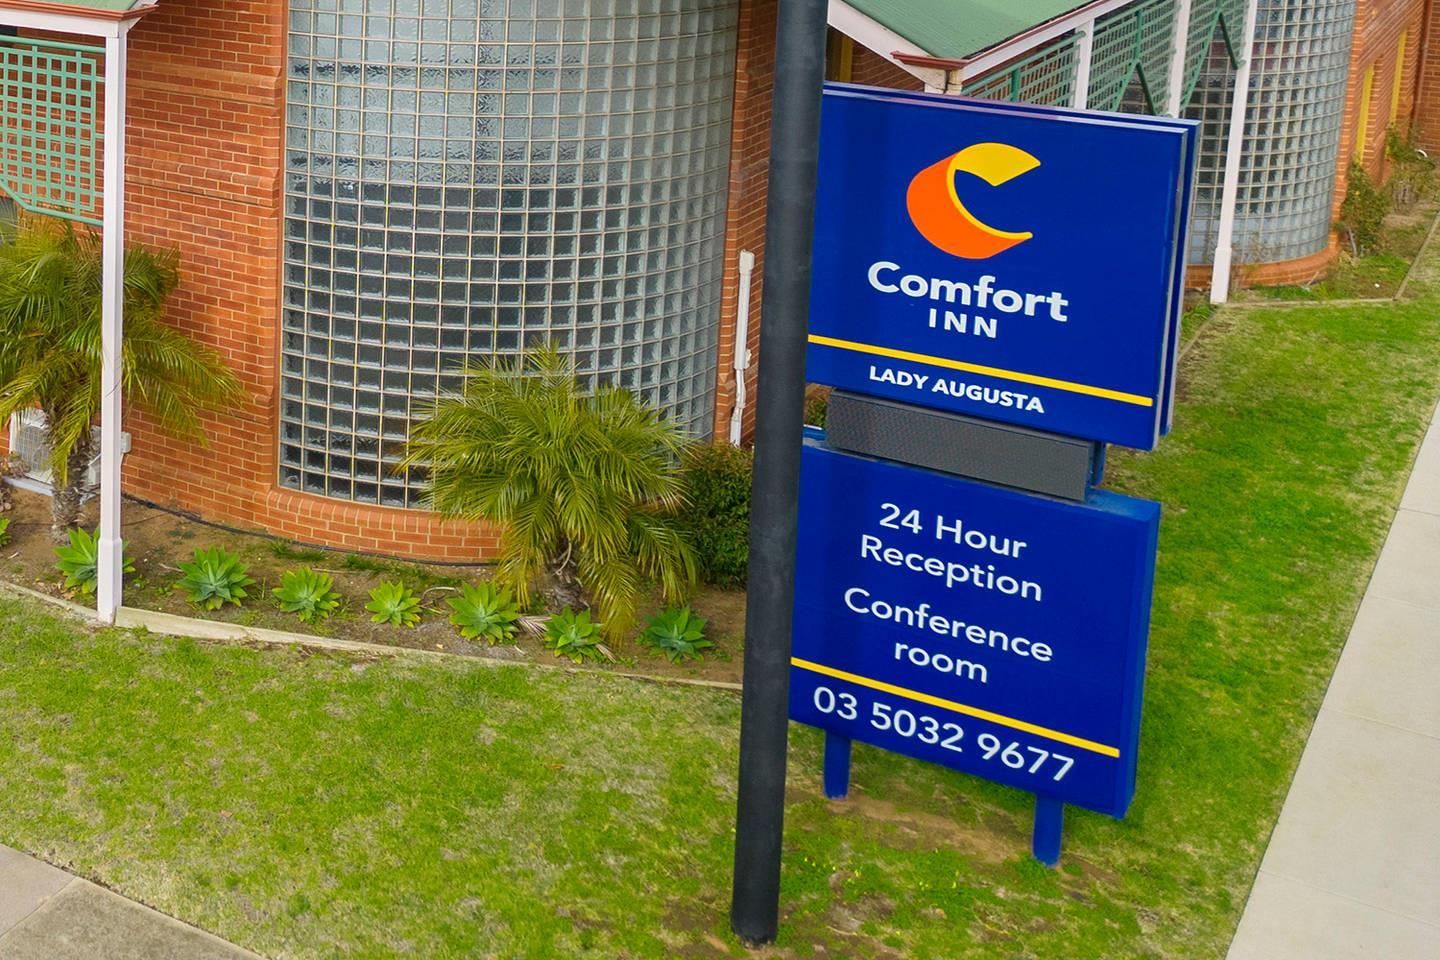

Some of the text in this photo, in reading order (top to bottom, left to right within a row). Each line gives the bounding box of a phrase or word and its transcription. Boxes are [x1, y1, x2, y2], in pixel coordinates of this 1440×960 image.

[866, 260, 1070, 323] Comfort
[928, 307, 999, 340] INN
[868, 364, 1046, 415] LADY AUGUSTA
[878, 501, 1028, 559] 24 Hour
[860, 533, 1043, 603] Reception
[843, 586, 1054, 663] Conference
[893, 641, 989, 684] room
[812, 685, 1076, 783] 03 5032 9677
